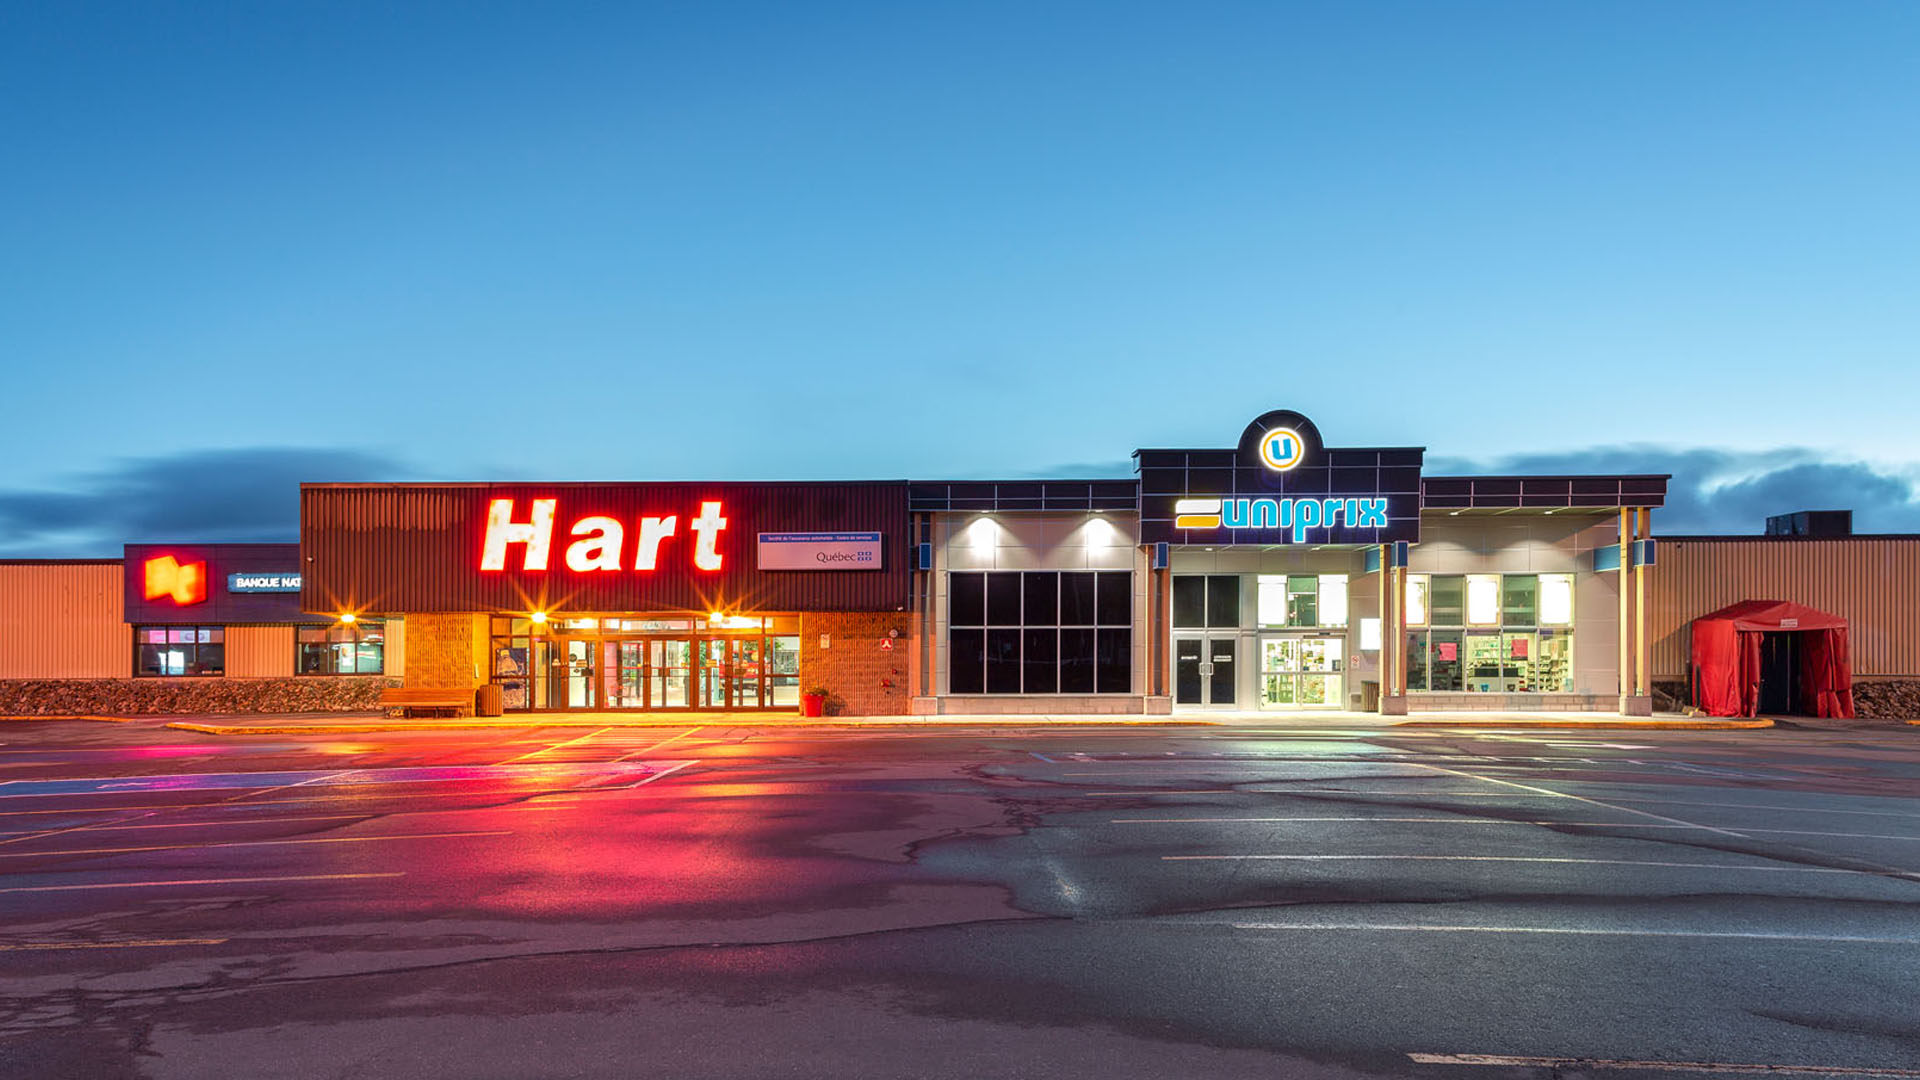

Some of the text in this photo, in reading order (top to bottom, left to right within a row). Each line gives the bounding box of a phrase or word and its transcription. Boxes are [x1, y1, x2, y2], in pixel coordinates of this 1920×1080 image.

[1222, 498, 1388, 543] uniprix
[480, 499, 727, 572] Hart
[816, 552, 856, 563] Québec
[236, 577, 280, 588] BANQUE
